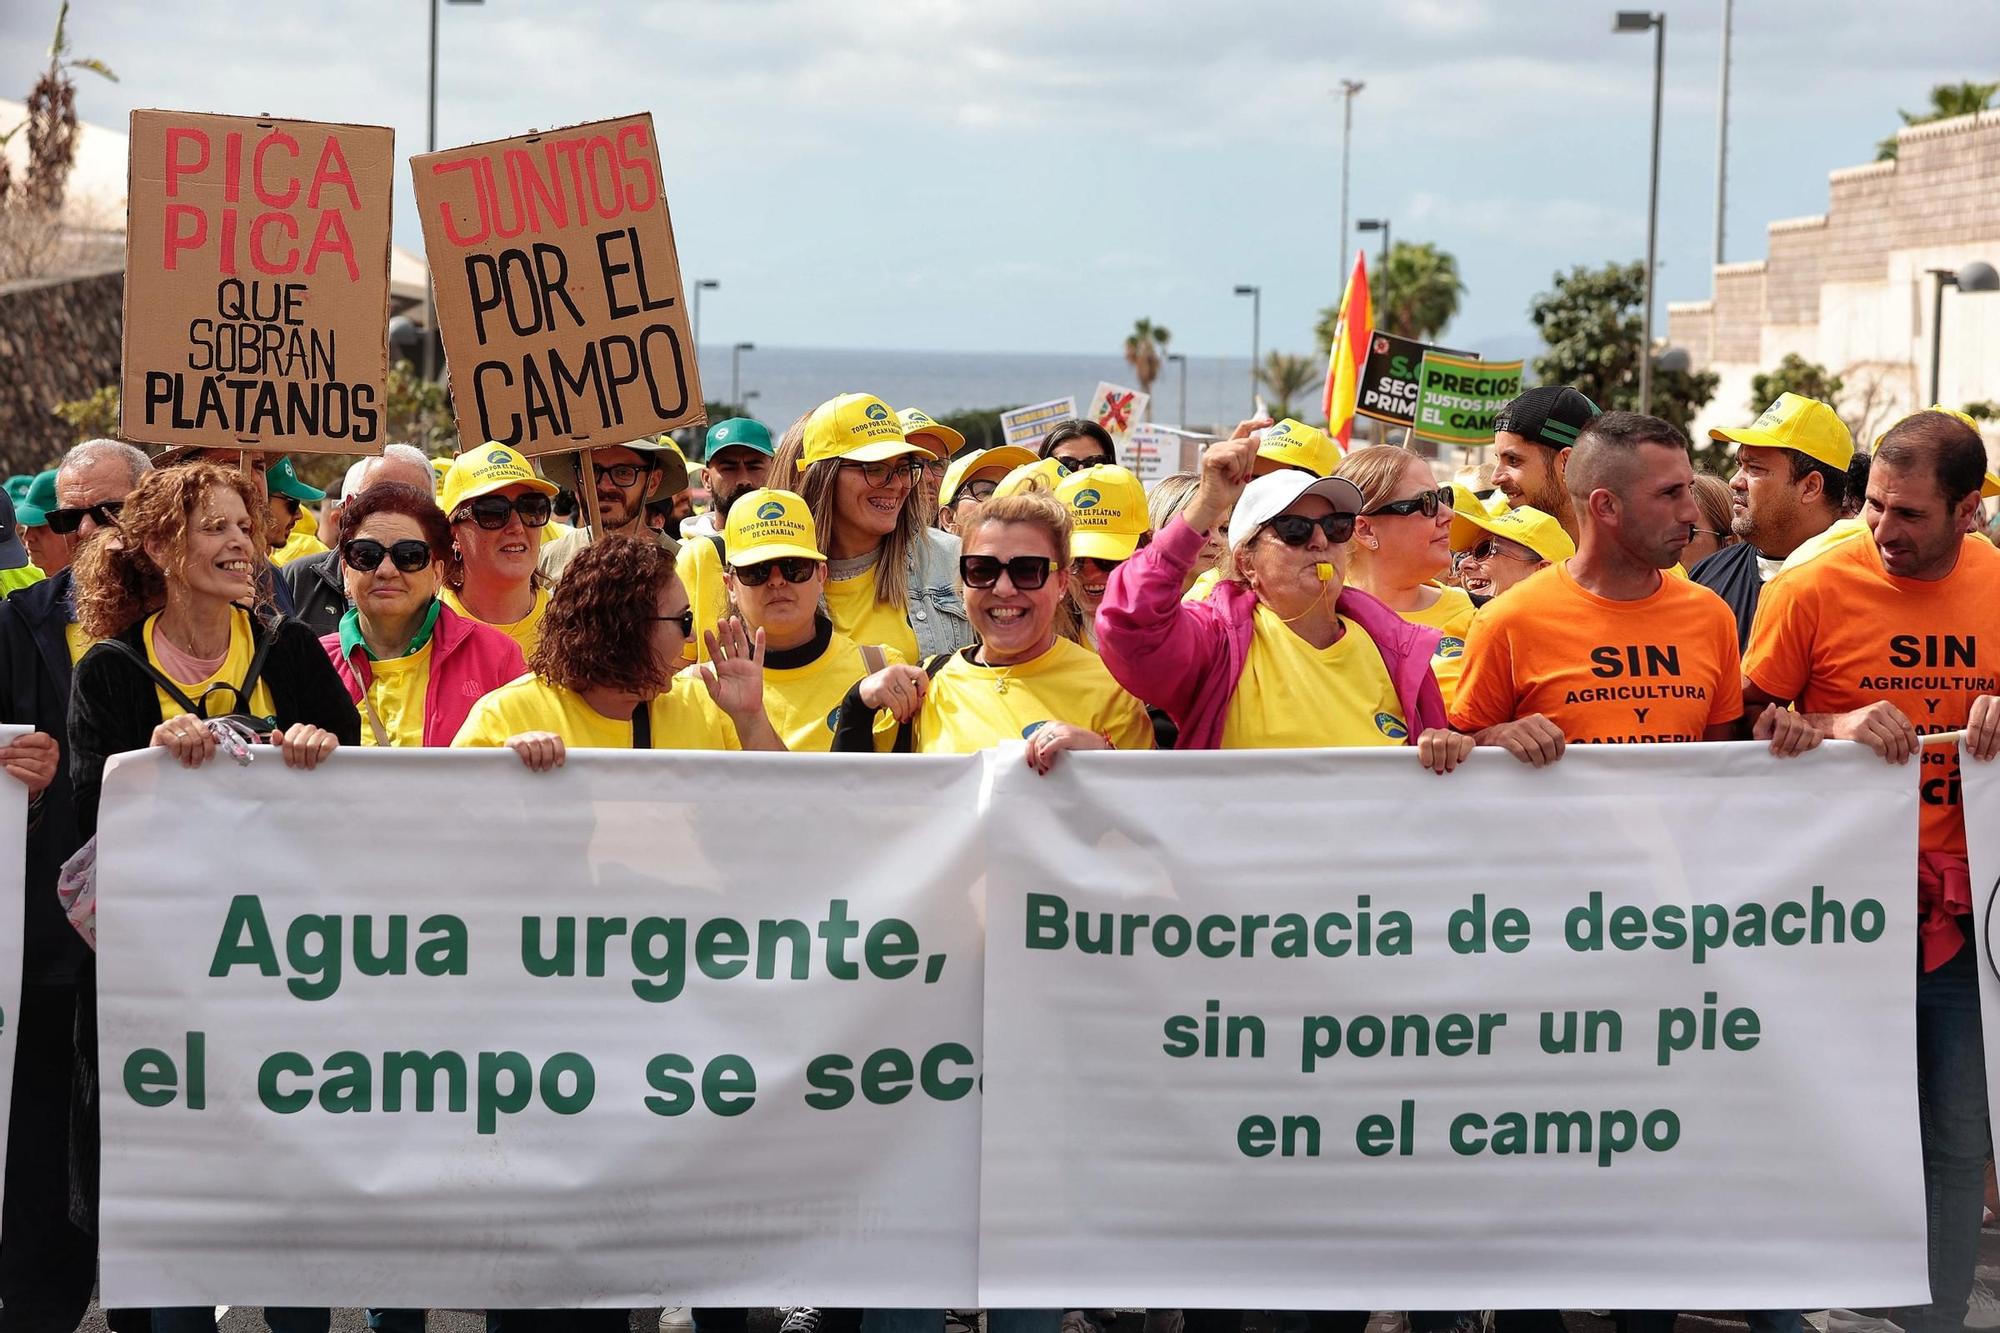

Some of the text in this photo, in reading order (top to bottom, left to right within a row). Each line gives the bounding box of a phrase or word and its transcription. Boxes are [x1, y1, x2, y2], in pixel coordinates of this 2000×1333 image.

[165, 127, 362, 212] PICA
[432, 124, 657, 248] JUNTOS
[163, 203, 362, 283] PICA
[217, 278, 308, 325] QUE
[465, 227, 675, 345] POR EL
[188, 317, 335, 383] SOBRAN
[473, 324, 688, 447] CAMPO
[1427, 370, 1518, 396] PRECIOS
[145, 371, 378, 443] PLÁTANOS
[1421, 407, 1444, 425] EL
[1424, 392, 1514, 412] JUSTOS PAR
[851, 423, 868, 434] TODO
[869, 420, 880, 430] POR
[867, 429, 876, 437] DE
[739, 524, 755, 534] TODO
[755, 521, 769, 529] POR
[1075, 518, 1107, 526] CANARIAS
[1092, 508, 1121, 517] PLÁTANO
[761, 528, 794, 536] CANARIAS
[1590, 645, 1681, 678] SIN
[1889, 634, 1976, 668] SIN
[1565, 685, 1706, 704] AGRICULTURA
[1859, 676, 1995, 691] AGRICULTURA
[1633, 707, 1650, 724] Y
[1924, 698, 1941, 714] Y
[1026, 886, 1887, 963] Burocracia de despacho
[209, 895, 946, 1002] Agua urgente,
[1162, 992, 1761, 1072] sin poner un pie
[123, 1031, 983, 1134] el campo se sec
[1237, 1100, 1682, 1167] en el campo
